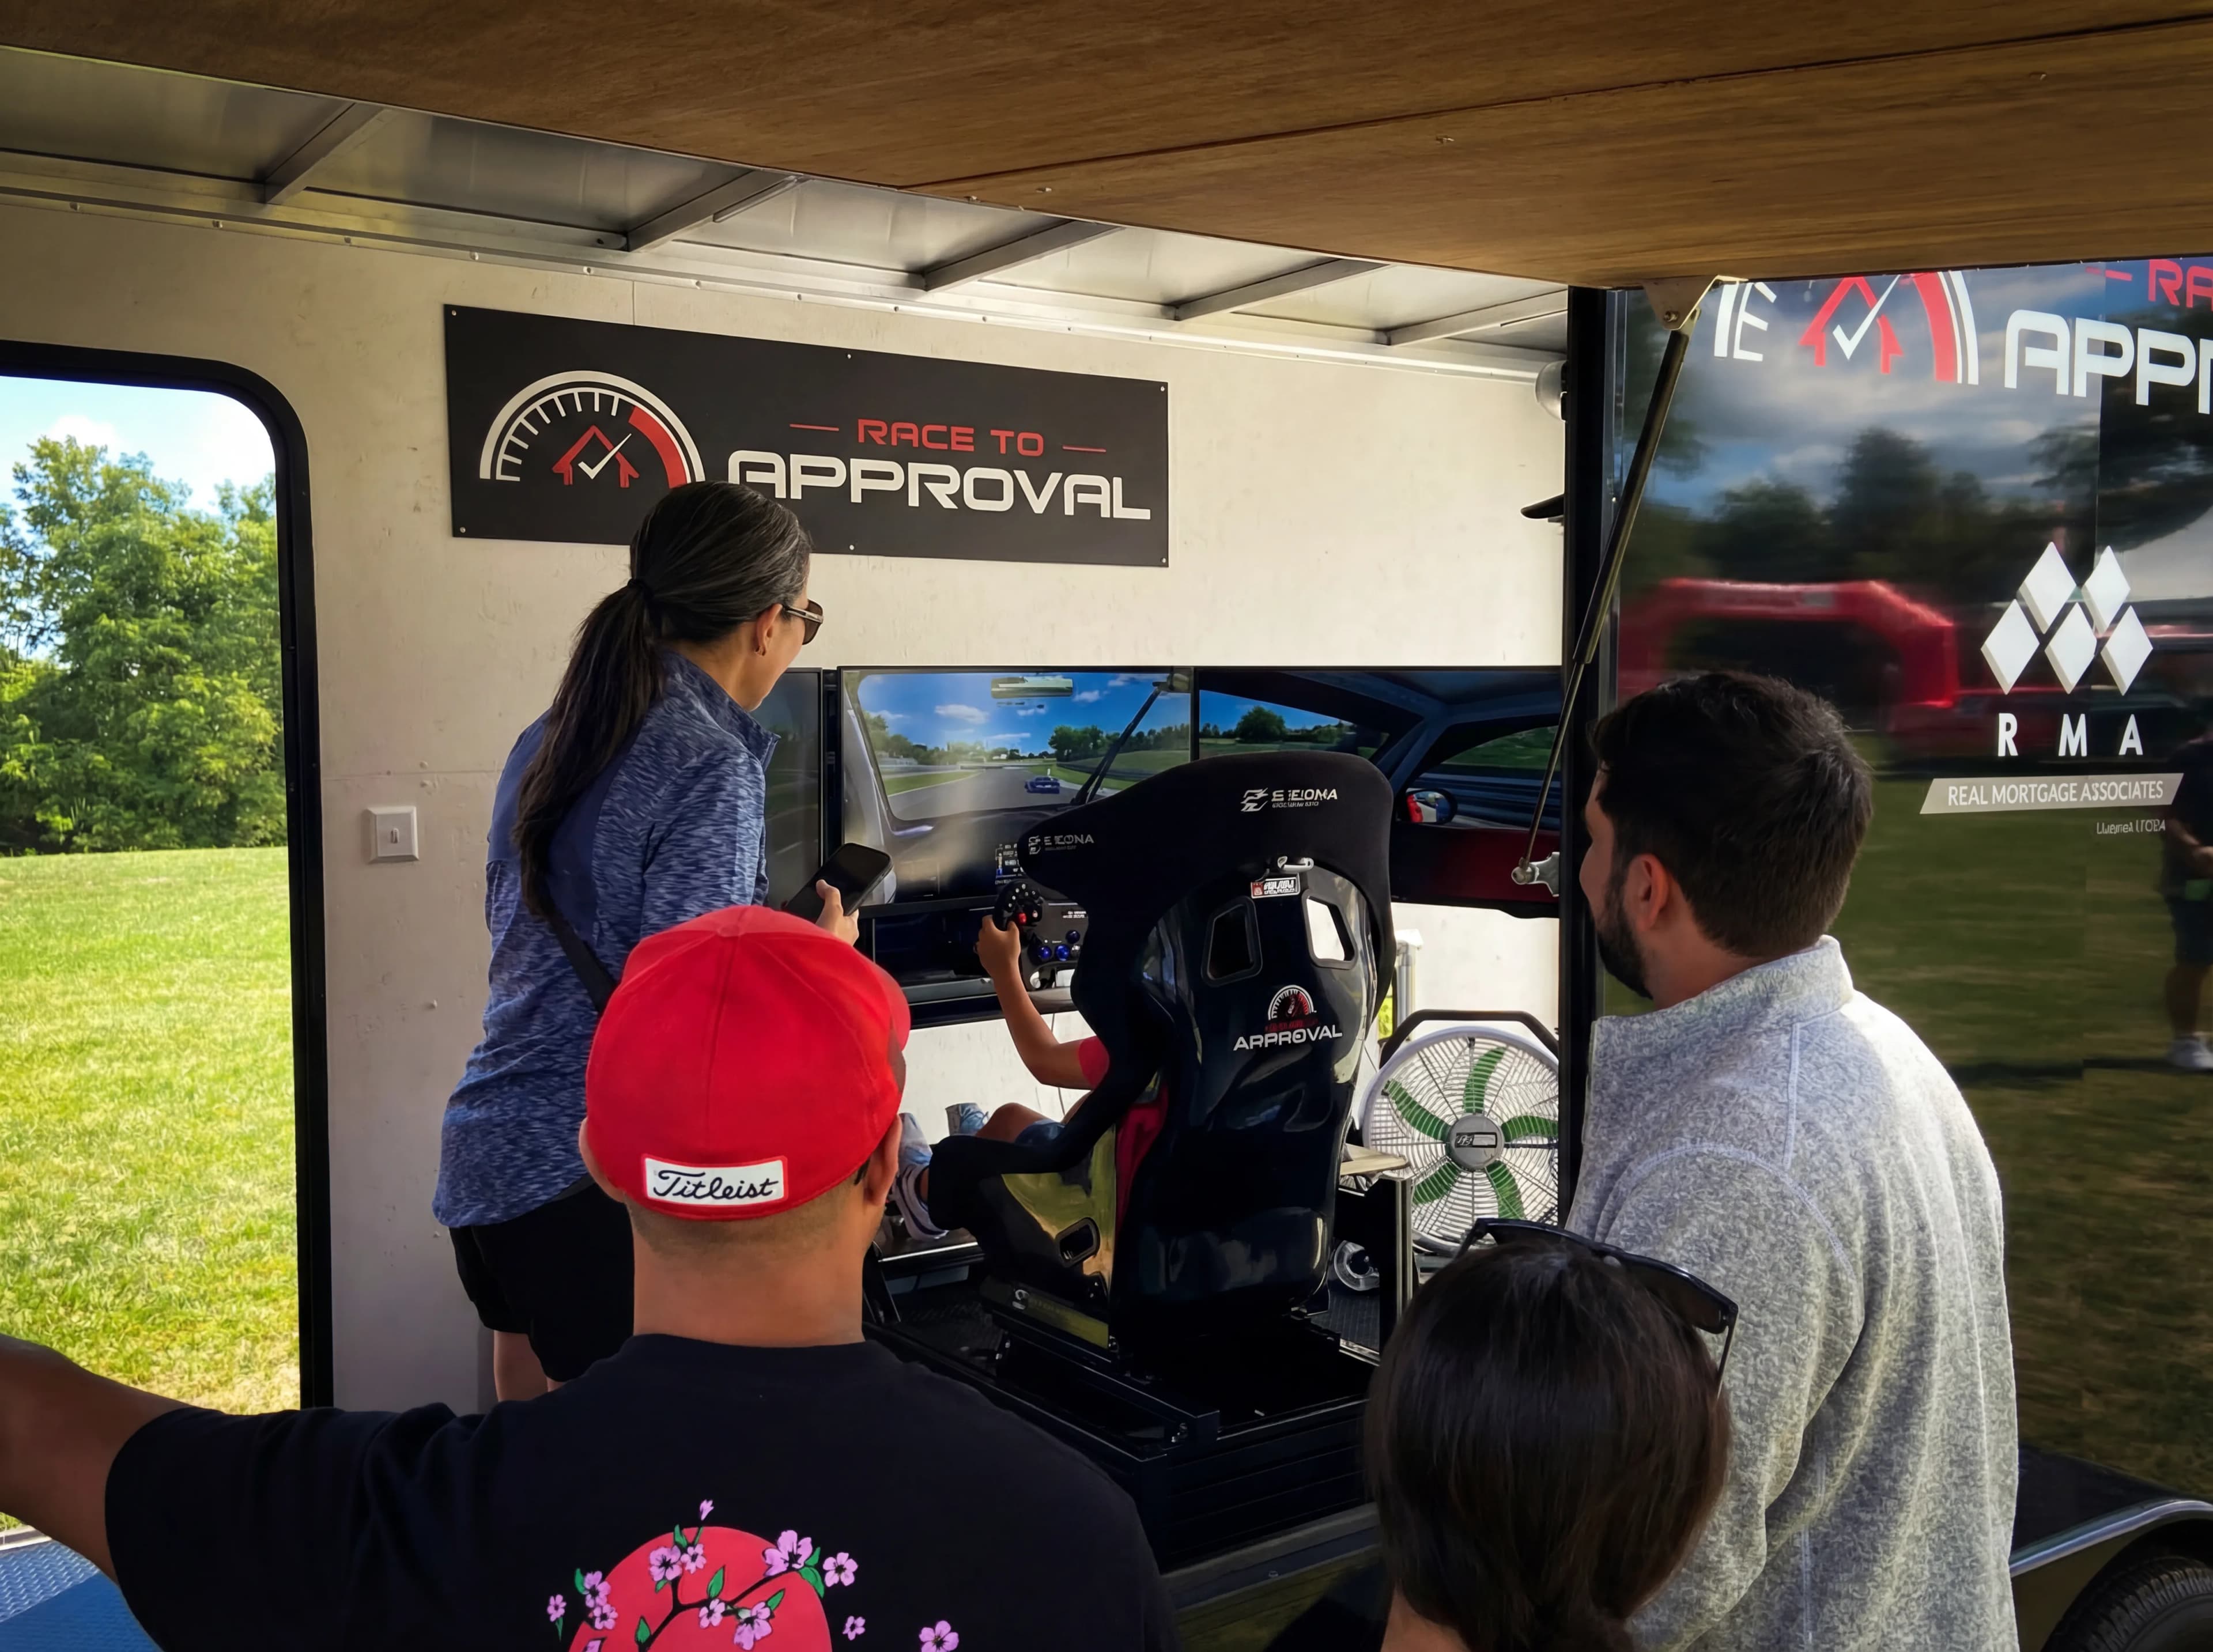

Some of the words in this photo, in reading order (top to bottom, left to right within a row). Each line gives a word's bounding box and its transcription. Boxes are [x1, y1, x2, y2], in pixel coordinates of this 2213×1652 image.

[2004, 309, 2213, 414] APP
[858, 418, 975, 452] RACE
[990, 429, 1044, 457] TO
[728, 449, 1151, 520] APPROVAL
[1947, 785, 1988, 806] REAL
[1992, 782, 2078, 804] MORTGAGE
[2080, 780, 2163, 802] ASSOCIATES
[653, 1170, 779, 1200] Titleist
